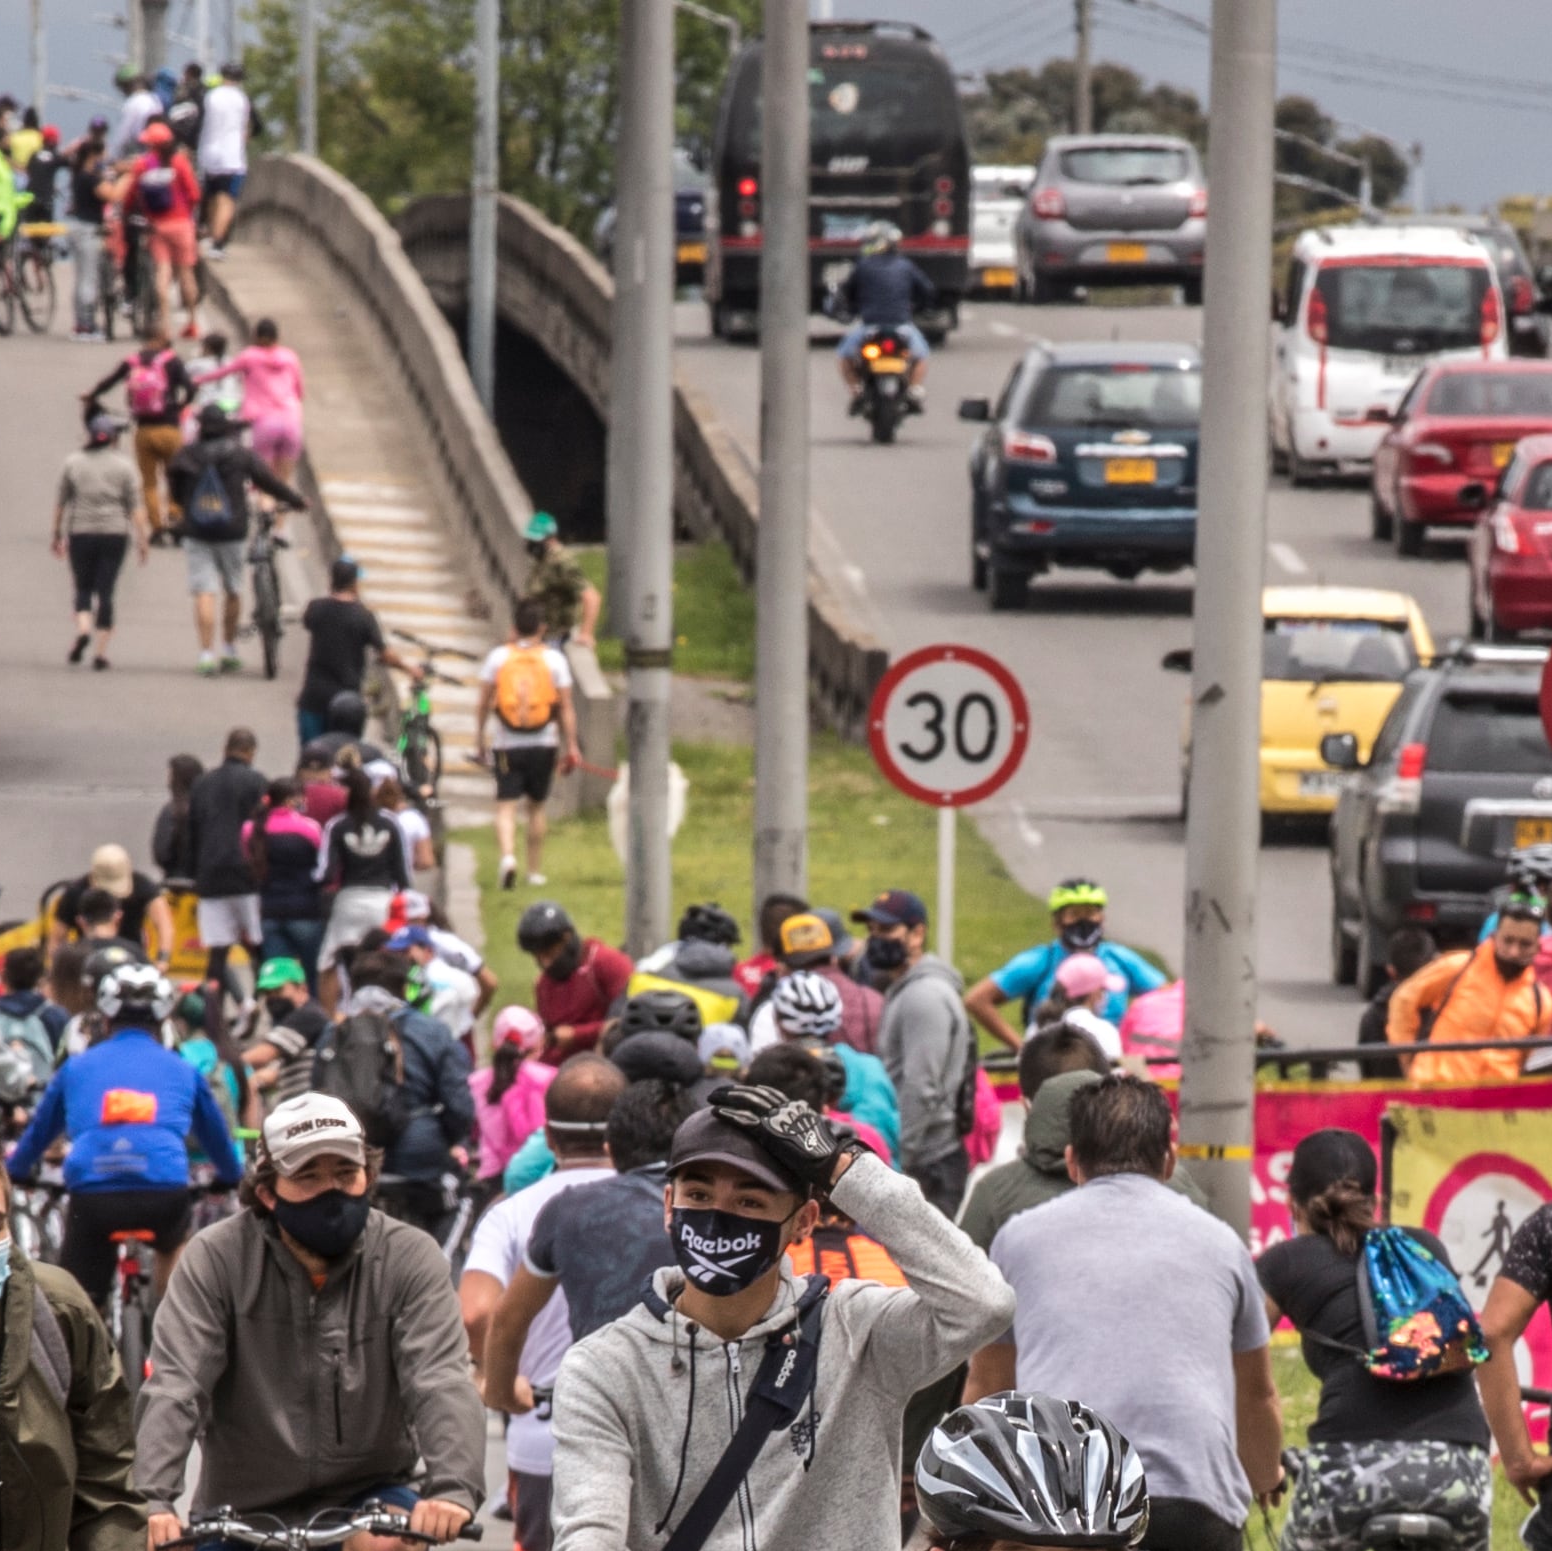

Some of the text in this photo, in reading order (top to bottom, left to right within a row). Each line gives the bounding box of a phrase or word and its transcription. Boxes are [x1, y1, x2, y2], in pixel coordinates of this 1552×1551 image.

[899, 692, 997, 764] 30
[681, 1223, 761, 1254] Reebok
[774, 1348, 797, 1388] adidas
